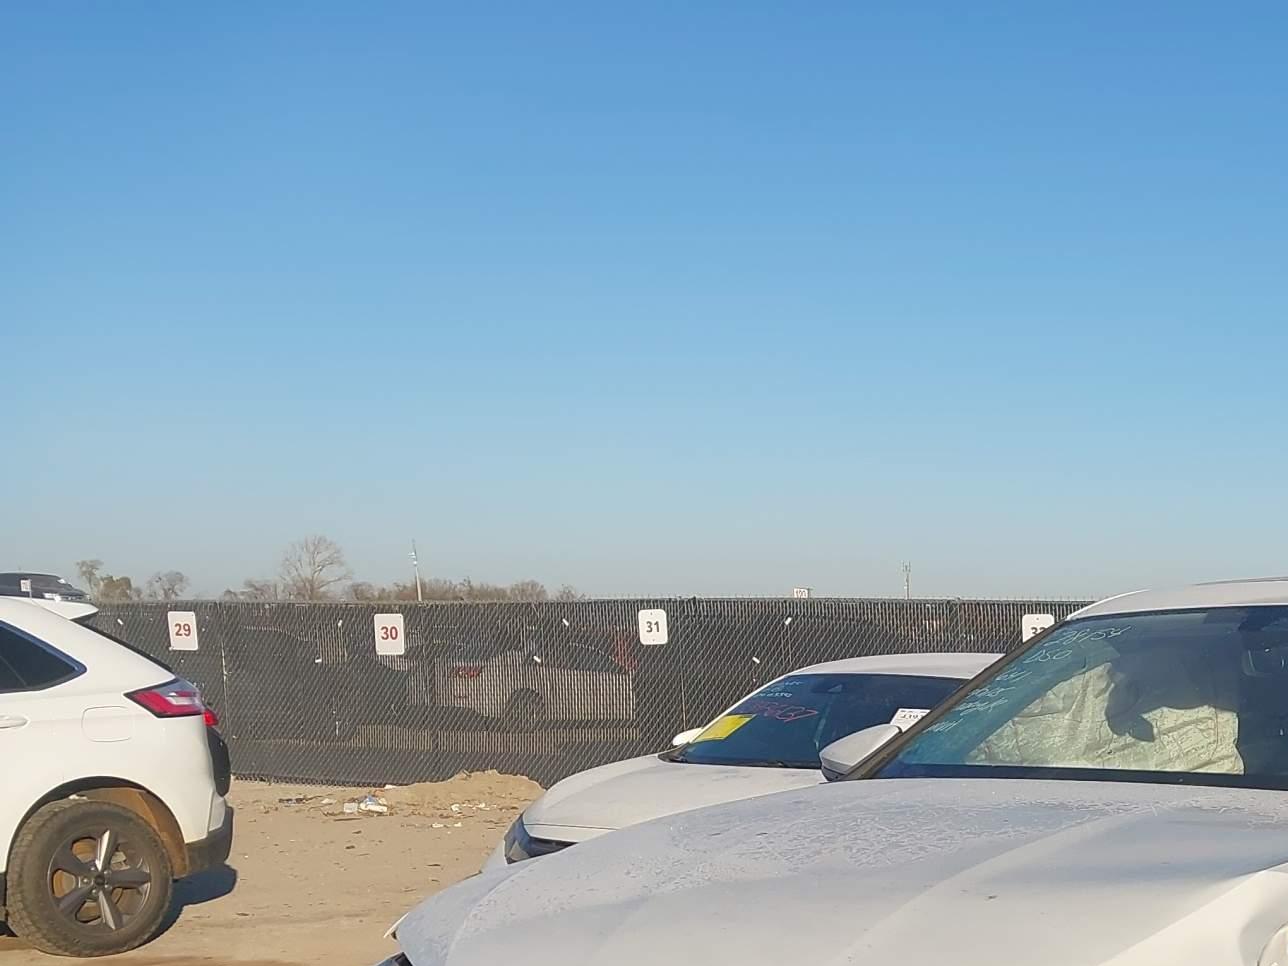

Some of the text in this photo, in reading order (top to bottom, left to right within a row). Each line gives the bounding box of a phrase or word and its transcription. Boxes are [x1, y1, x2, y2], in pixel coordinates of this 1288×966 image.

[174, 622, 192, 637] 29
[380, 626, 399, 640] 30
[645, 620, 660, 633] 31
